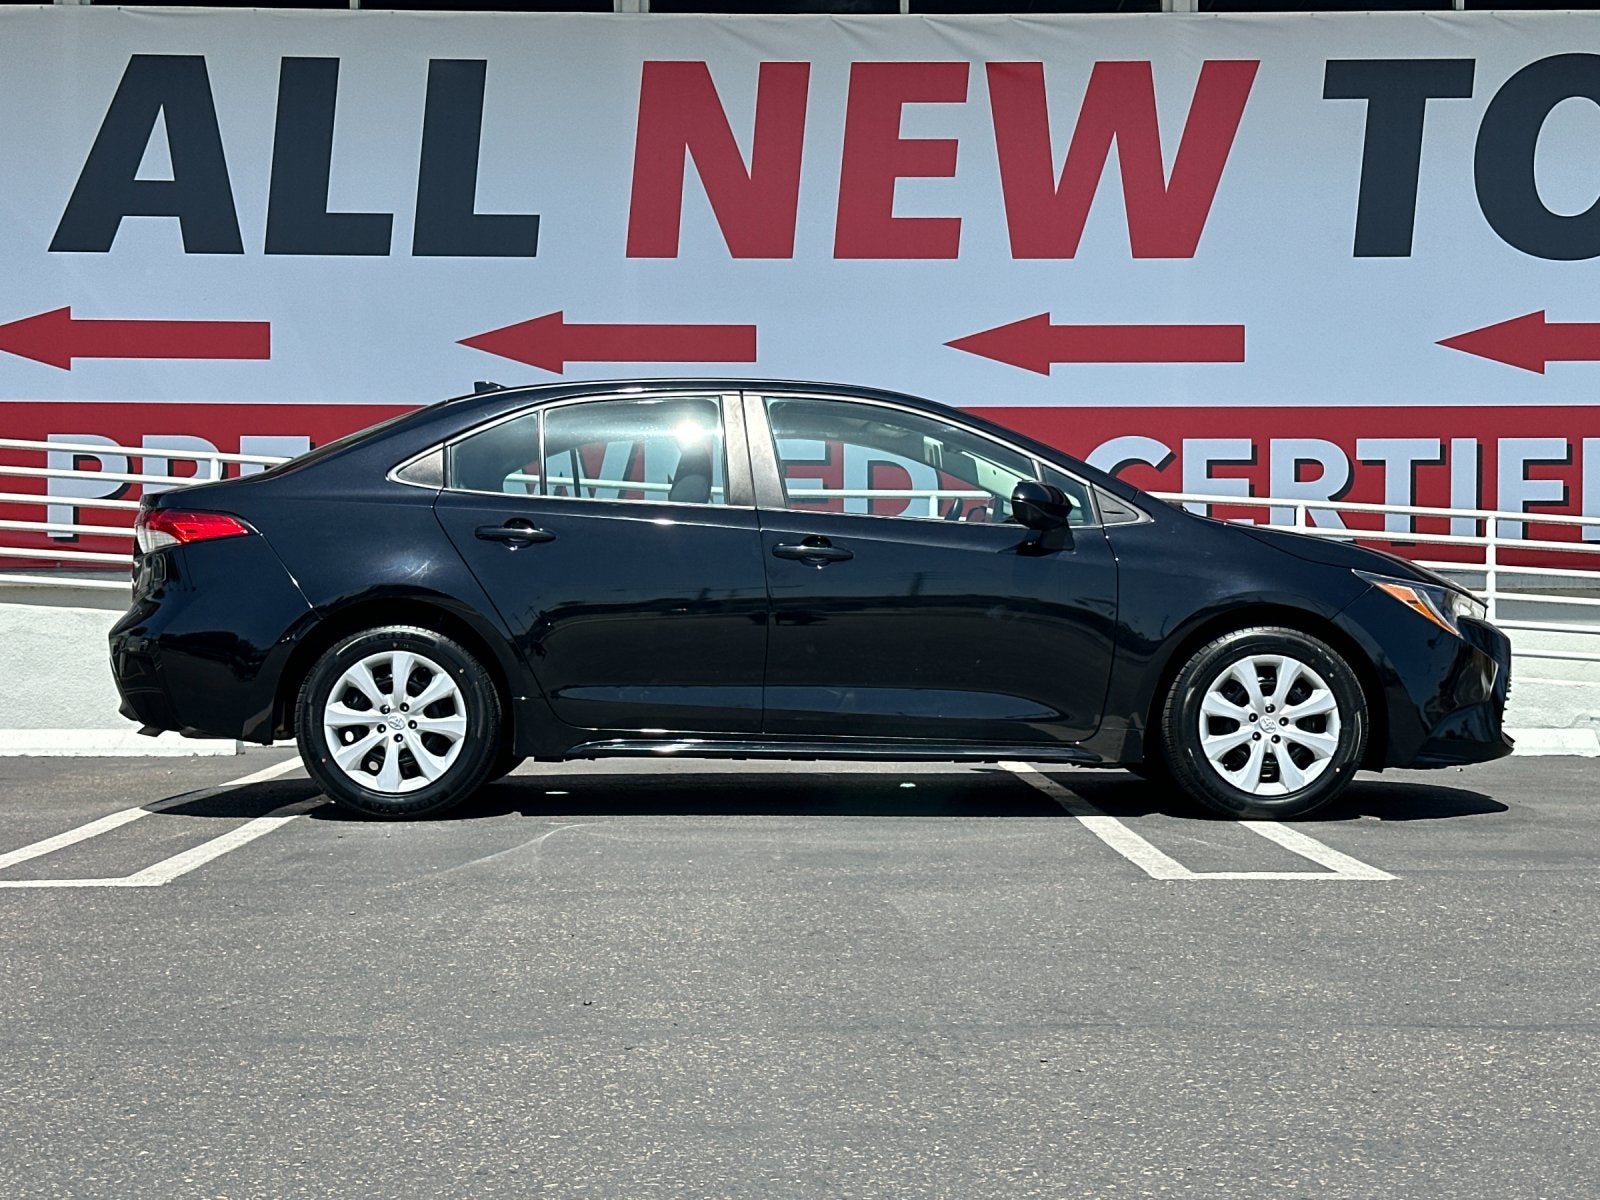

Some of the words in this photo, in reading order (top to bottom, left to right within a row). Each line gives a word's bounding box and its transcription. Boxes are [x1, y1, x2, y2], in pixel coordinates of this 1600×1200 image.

[48, 54, 540, 257] ALL
[626, 60, 1260, 259] NEW
[1082, 435, 1600, 543] CERTIF
